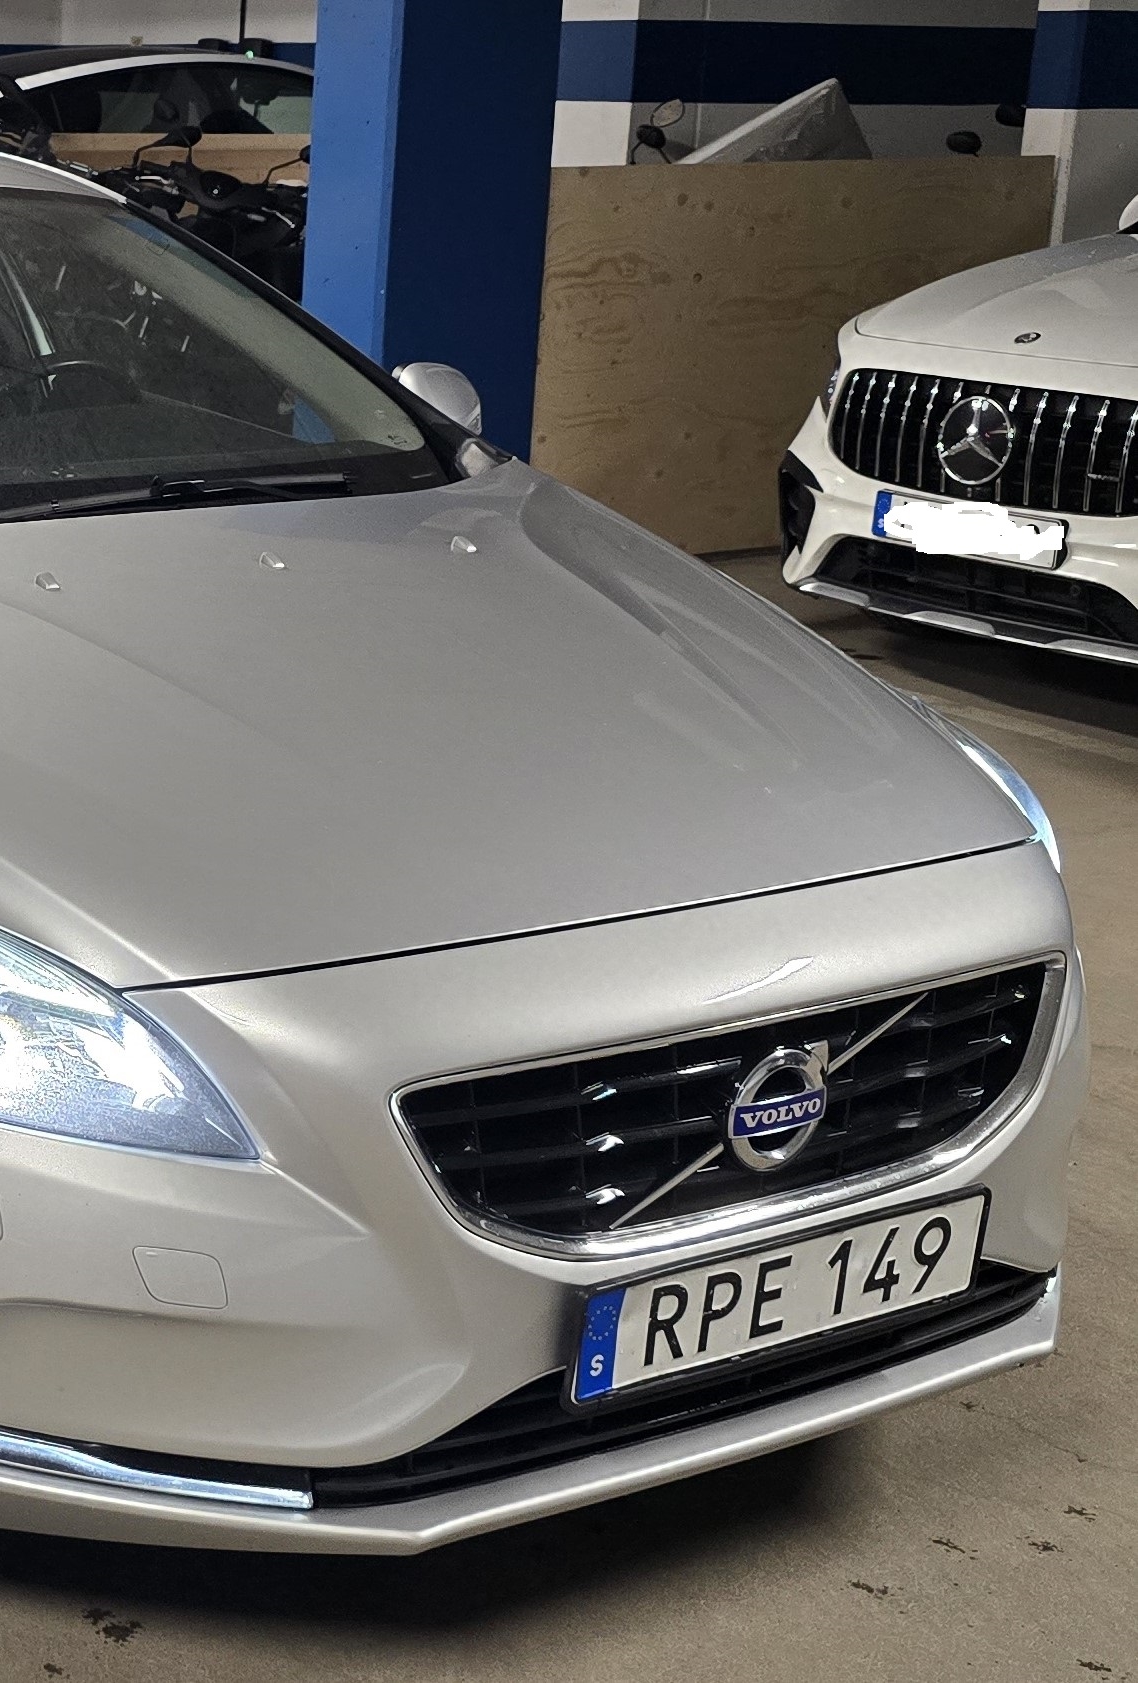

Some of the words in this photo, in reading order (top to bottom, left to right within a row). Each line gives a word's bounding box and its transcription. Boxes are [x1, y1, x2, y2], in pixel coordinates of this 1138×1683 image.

[740, 1097, 821, 1128] VOLVO
[643, 1254, 793, 1367] RPE
[827, 1216, 952, 1316] 149
[589, 1354, 605, 1377] S
